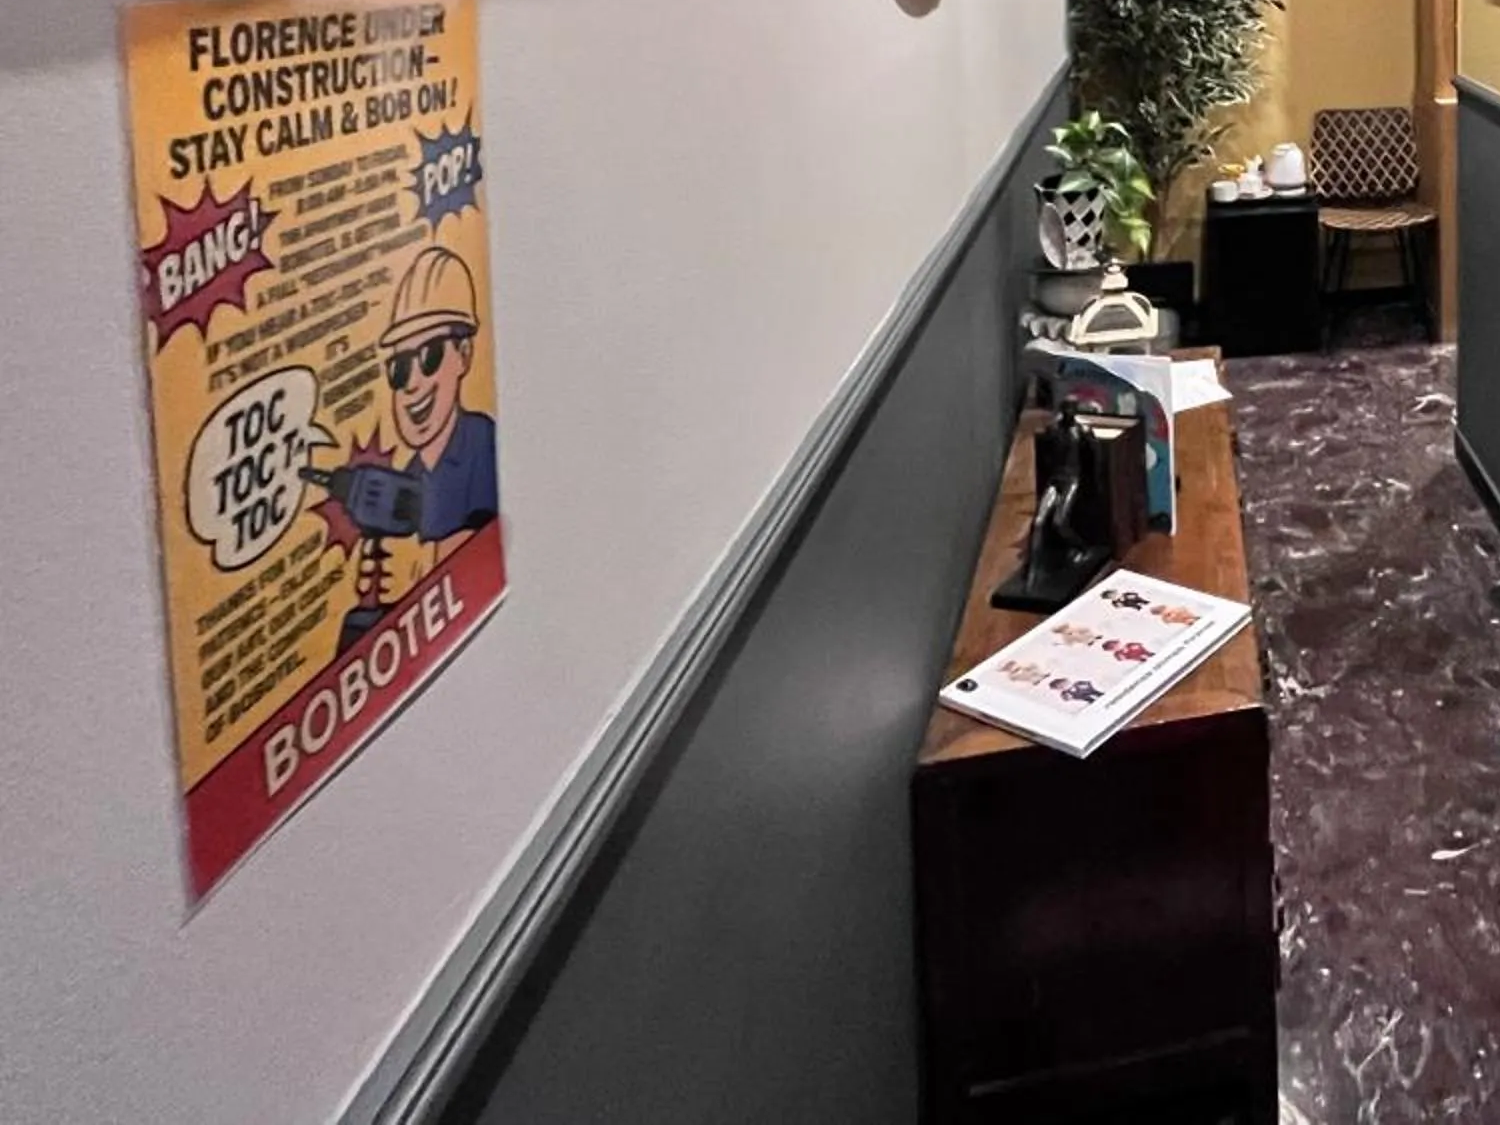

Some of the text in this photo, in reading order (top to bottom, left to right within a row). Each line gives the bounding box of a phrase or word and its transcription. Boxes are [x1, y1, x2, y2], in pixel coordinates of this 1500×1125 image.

[187, 2, 446, 71] FLORENCE UNDER
[168, 124, 250, 182] STAY
[254, 103, 333, 158] CALM
[339, 98, 360, 136] &
[365, 86, 412, 129] BOB
[422, 146, 474, 204] POP!
[159, 203, 262, 311] BANG!
[224, 385, 287, 460] TOC
[213, 439, 277, 518] TOC
[230, 481, 287, 555] TOC
[263, 574, 465, 798] BOBOTEL
